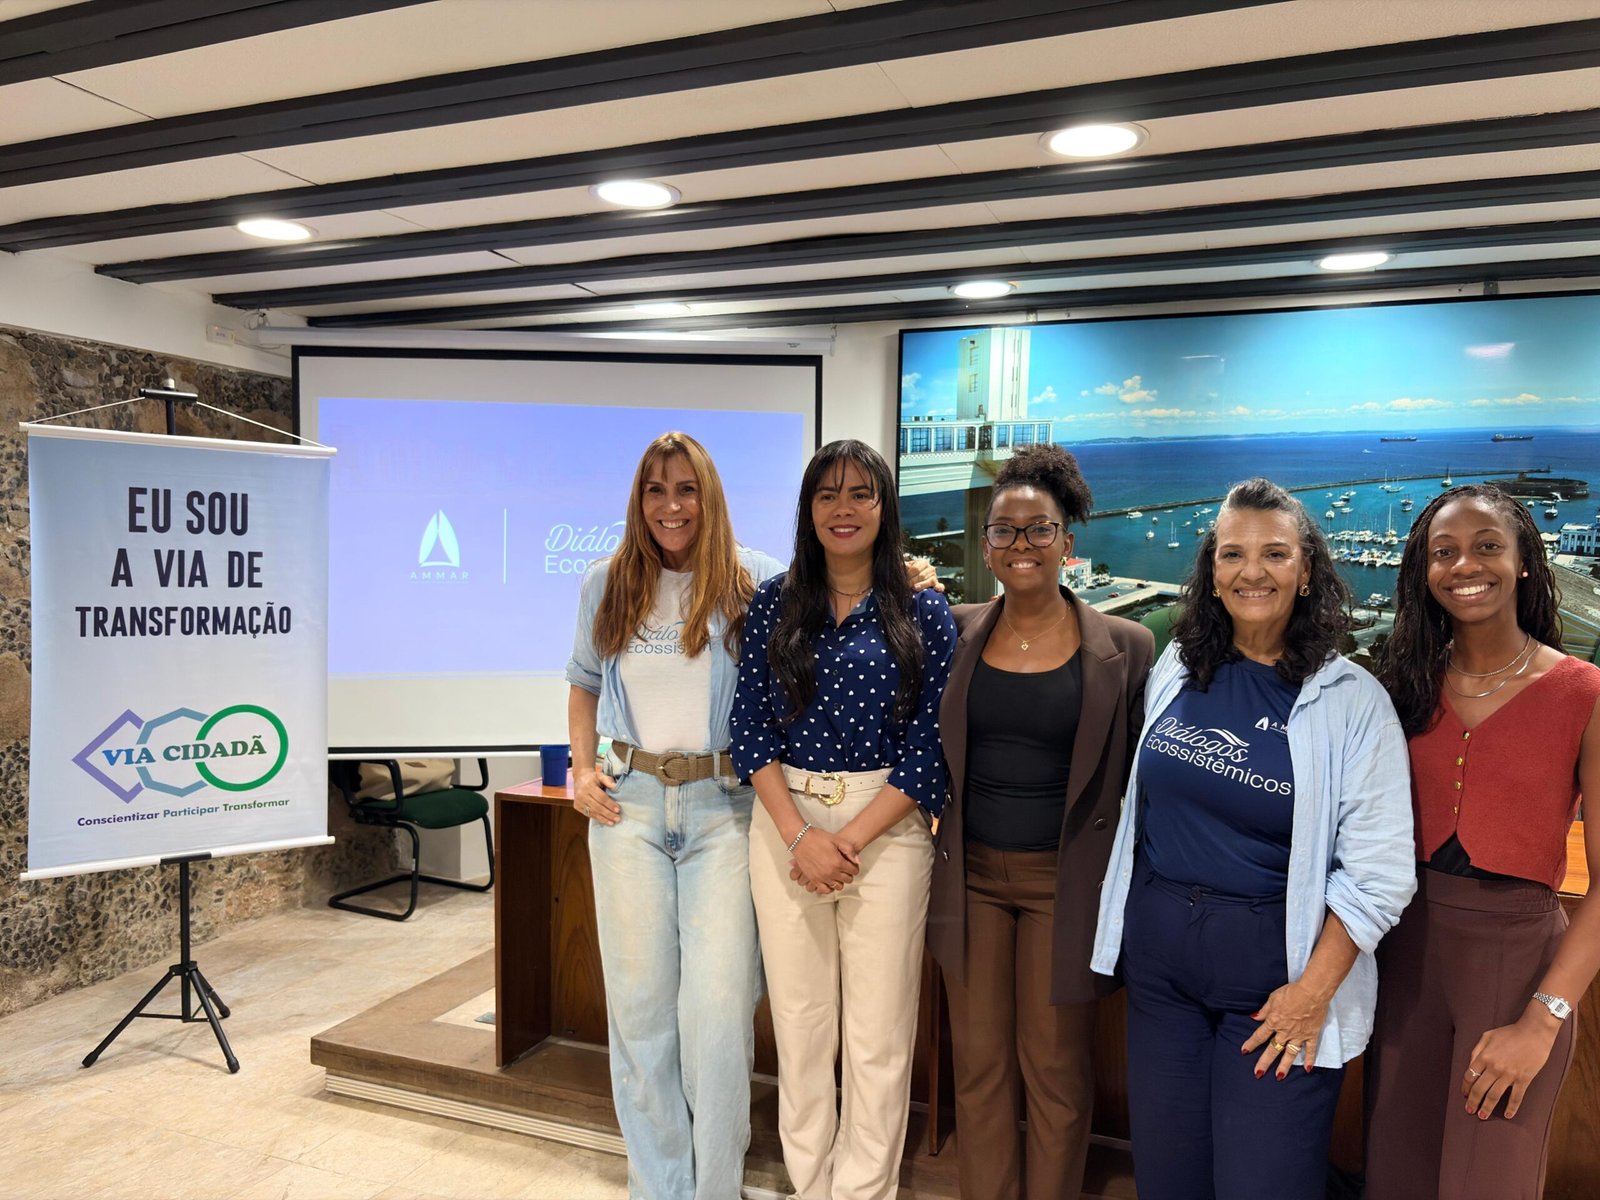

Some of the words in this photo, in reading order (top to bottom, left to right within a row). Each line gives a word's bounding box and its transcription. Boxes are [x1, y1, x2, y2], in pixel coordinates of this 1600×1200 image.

[128, 487, 171, 533] EU
[186, 490, 249, 536] SOU
[545, 523, 622, 552] Diálo
[110, 548, 133, 588] A
[153, 549, 209, 588] VIA
[227, 551, 264, 588] DE
[75, 602, 292, 639] TRANSFORMAÇÃO
[102, 747, 156, 766] VIA
[162, 735, 267, 762] CIDADÃ
[1154, 716, 1249, 763] Diálogos
[1145, 734, 1292, 795] Ecossistêmicos
[77, 811, 160, 827] Conscientizar
[163, 804, 220, 819] Participar
[222, 799, 290, 812] Transformar
